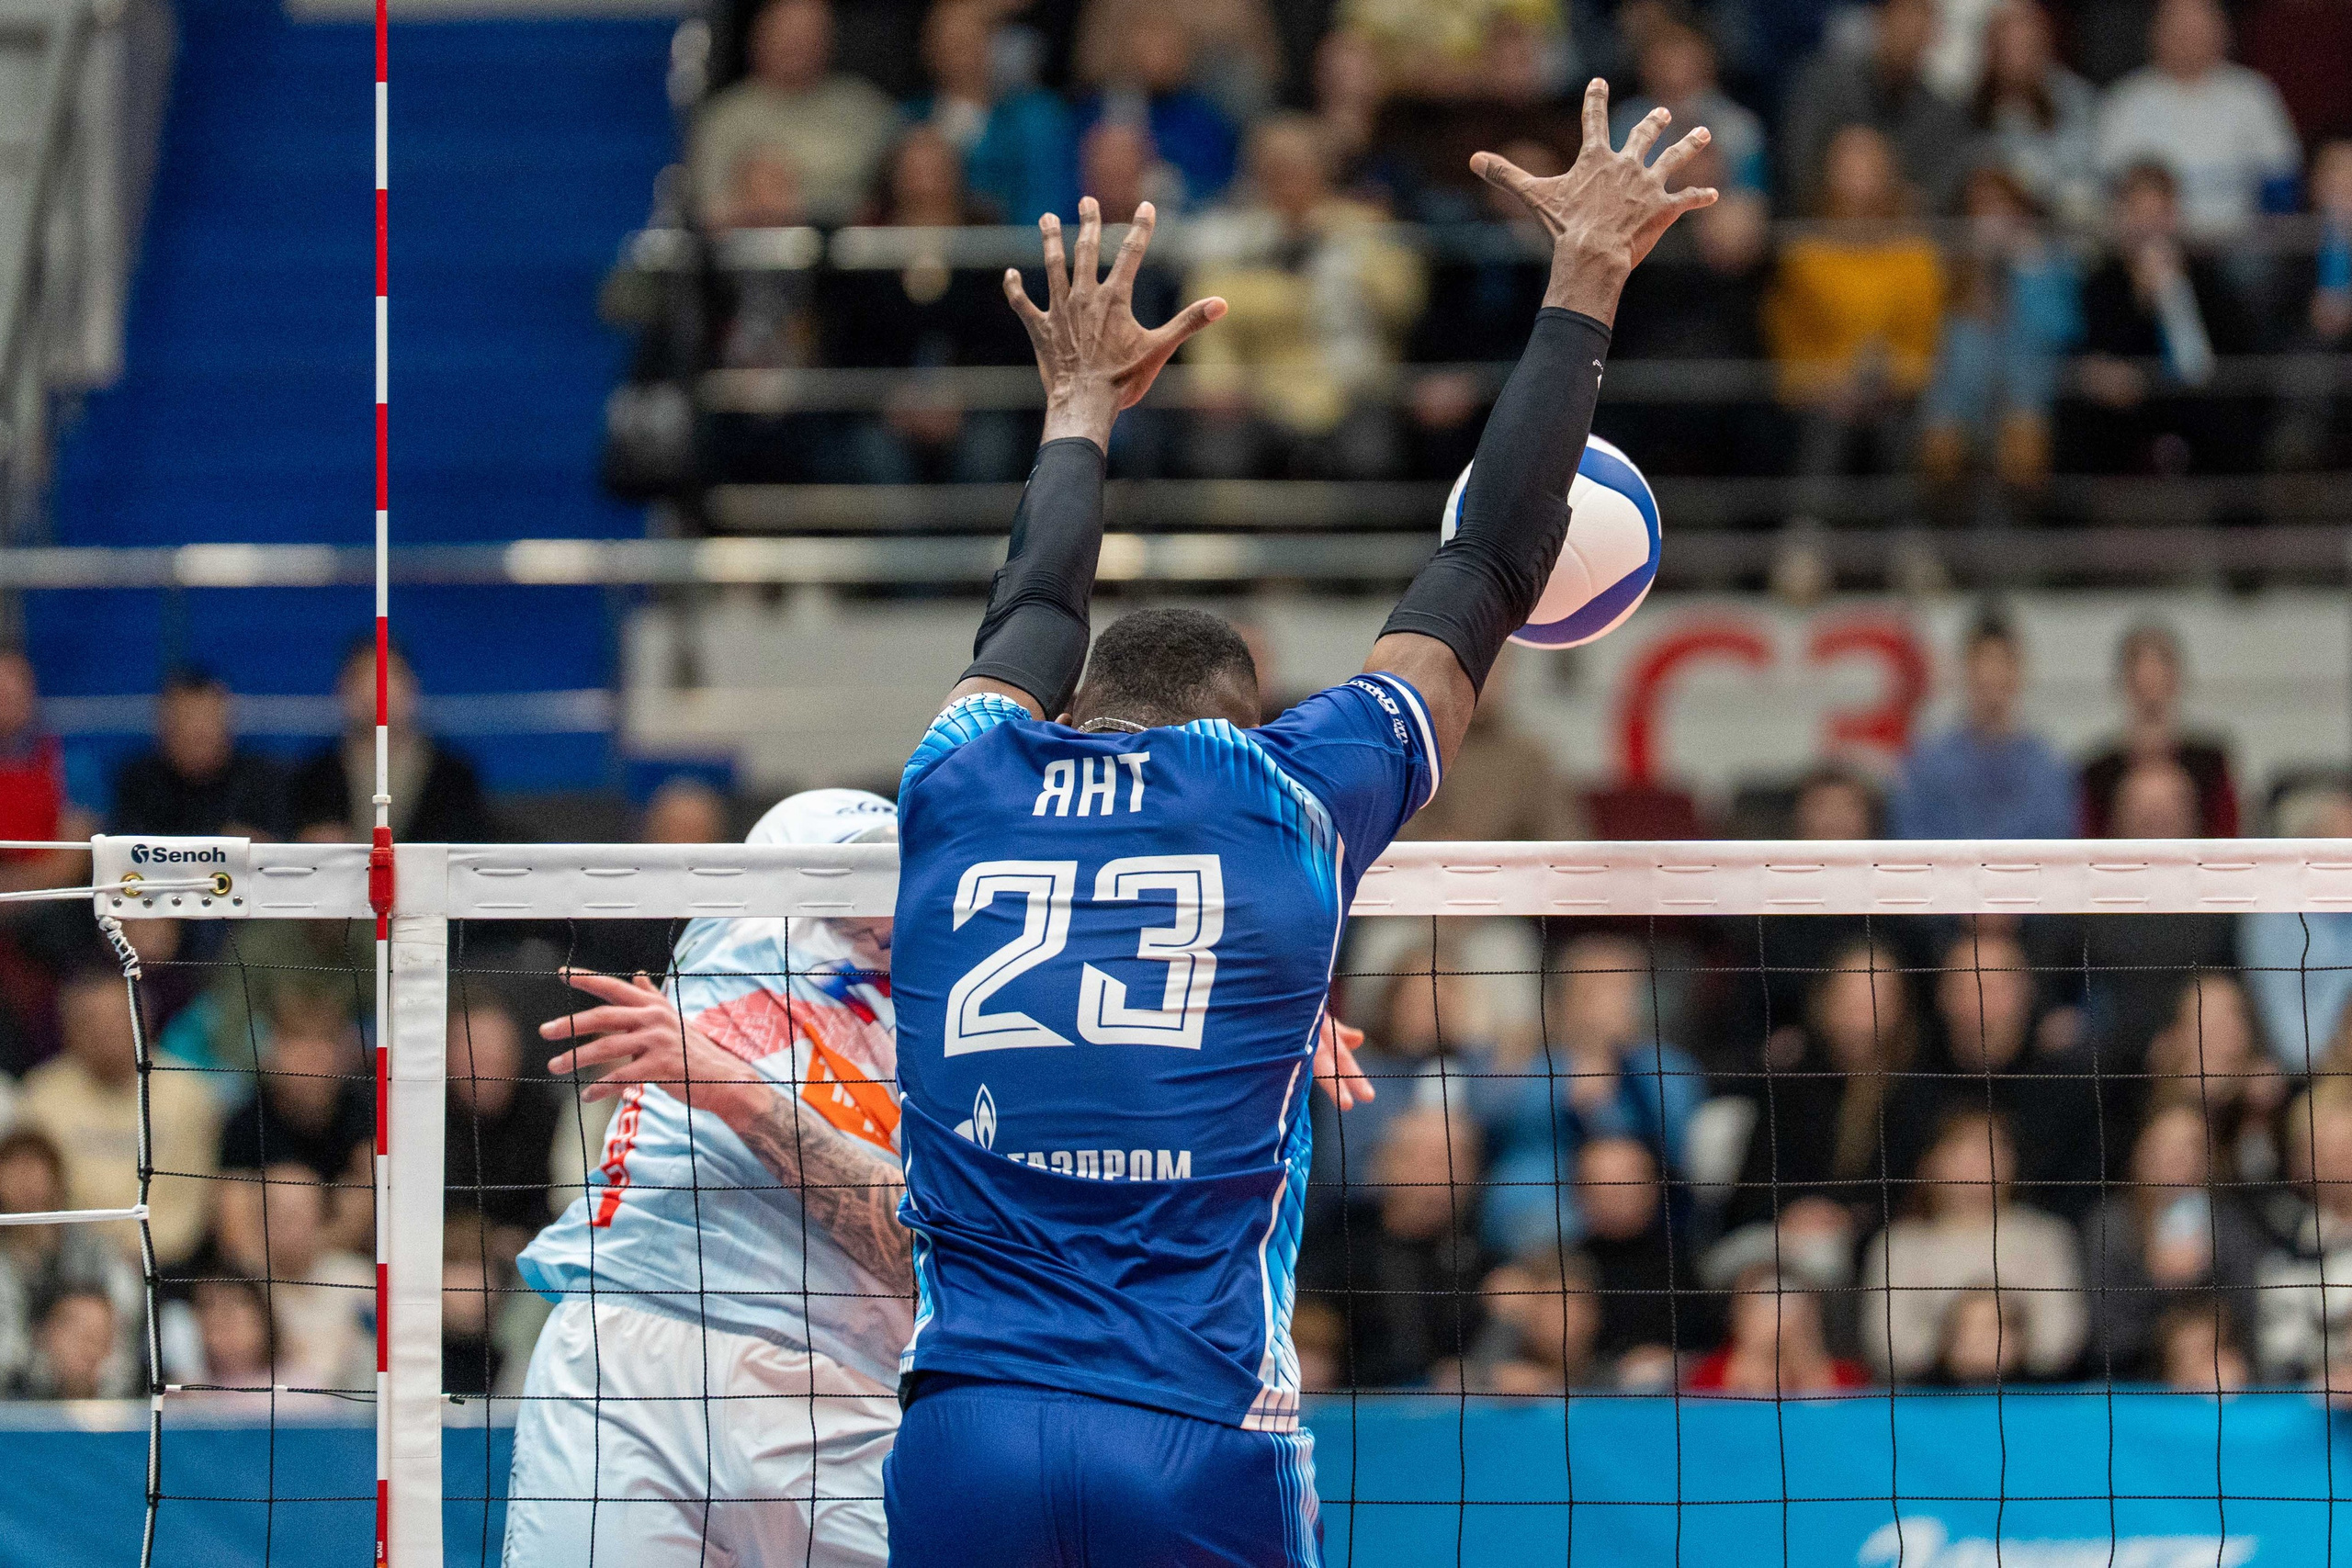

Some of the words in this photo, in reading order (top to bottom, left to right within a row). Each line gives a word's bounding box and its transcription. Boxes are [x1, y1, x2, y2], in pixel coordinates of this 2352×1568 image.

[1032, 751, 1150, 817] ЯНТ
[152, 847, 226, 863] Senoh
[944, 854, 1225, 1058] 23
